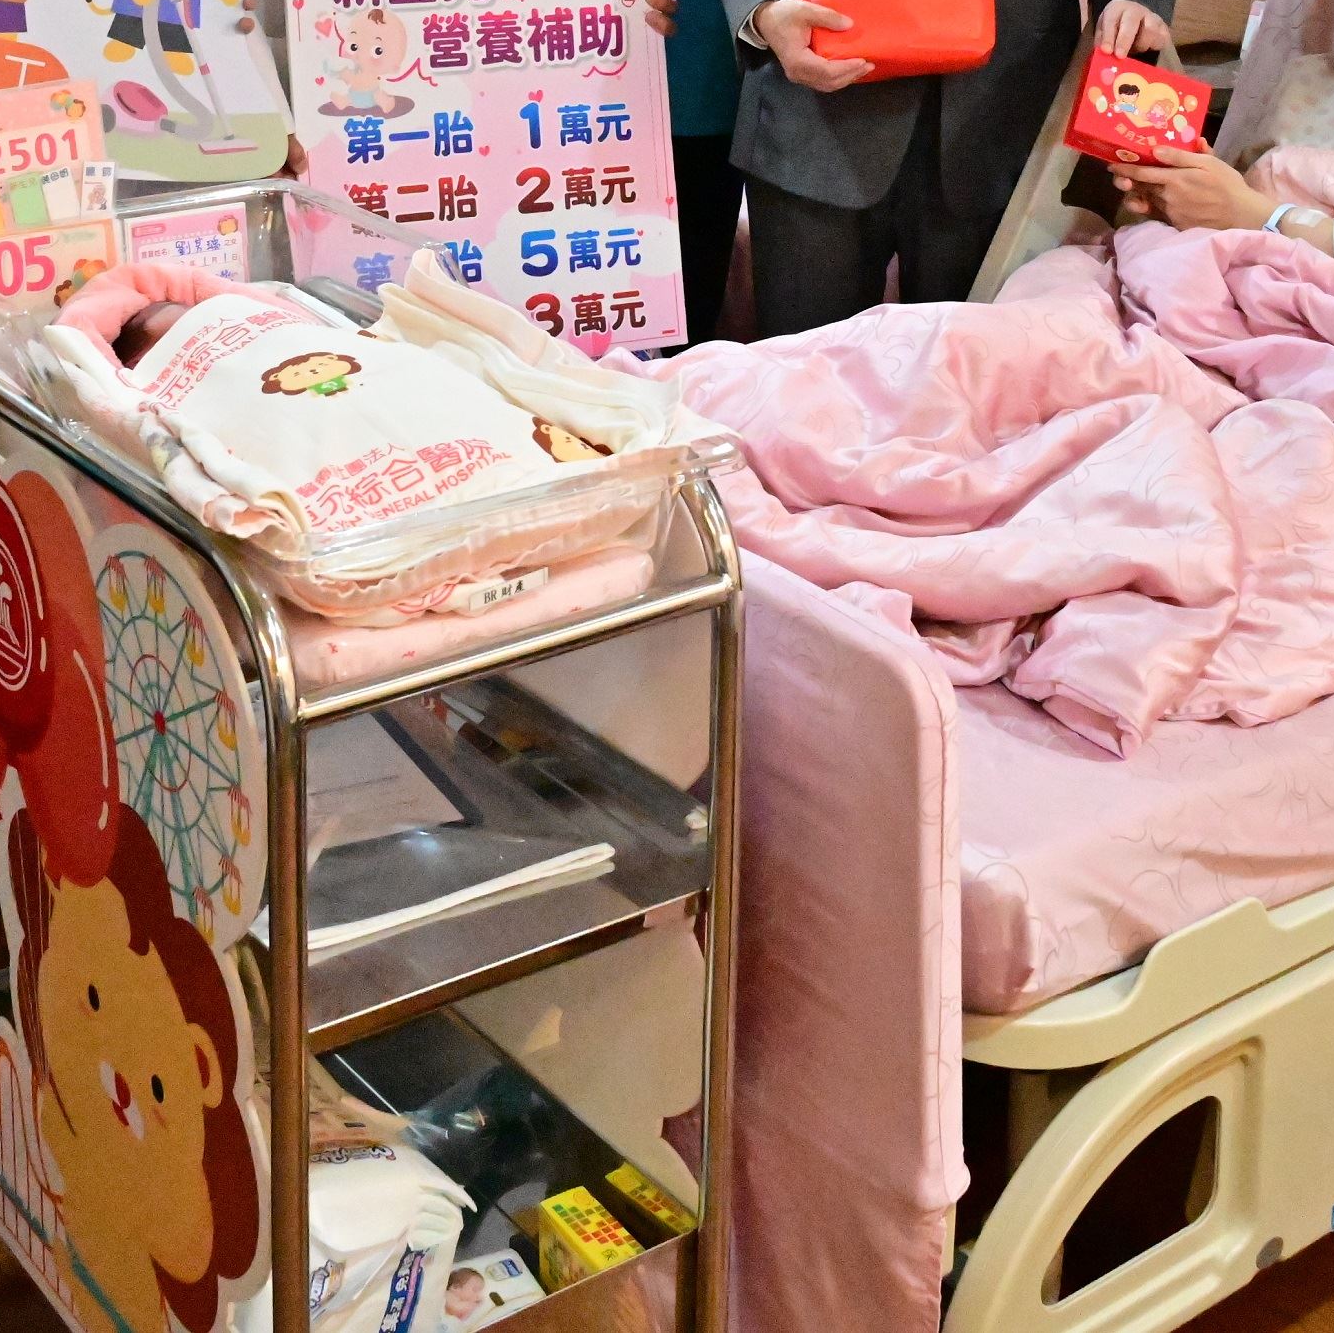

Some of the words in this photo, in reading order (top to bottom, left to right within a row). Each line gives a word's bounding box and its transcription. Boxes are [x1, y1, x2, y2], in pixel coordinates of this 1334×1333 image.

[422, 3, 624, 70] 營養補助
[343, 109, 475, 164] 第一胎
[348, 174, 480, 227] 第二胎
[353, 238, 484, 293] 第胎
[434, 451, 512, 495] HOSPITAL
[484, 589, 498, 605] BR
